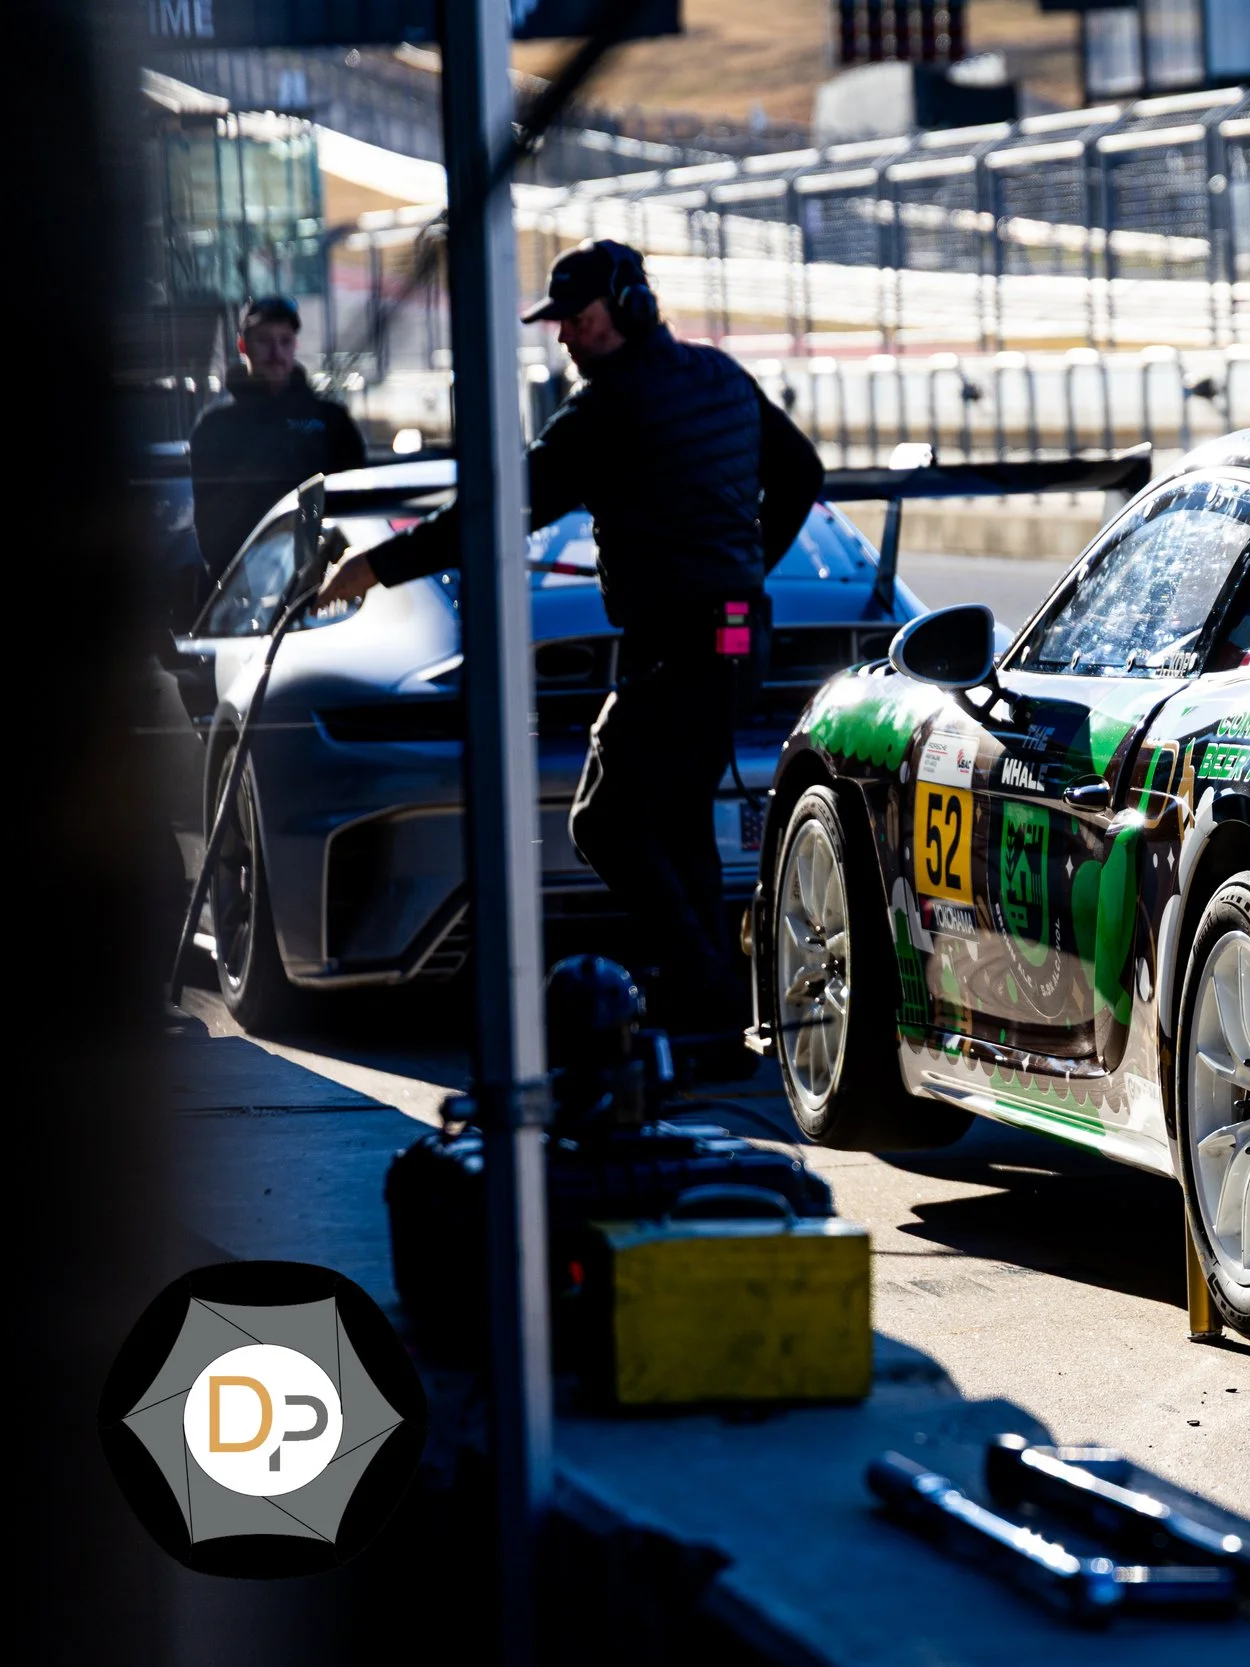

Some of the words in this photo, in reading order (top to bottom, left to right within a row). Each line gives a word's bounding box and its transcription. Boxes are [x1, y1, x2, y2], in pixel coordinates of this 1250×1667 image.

[1001, 757, 1049, 792] WHALE
[926, 792, 962, 890] 52
[933, 904, 977, 936] YOKOHAMA
